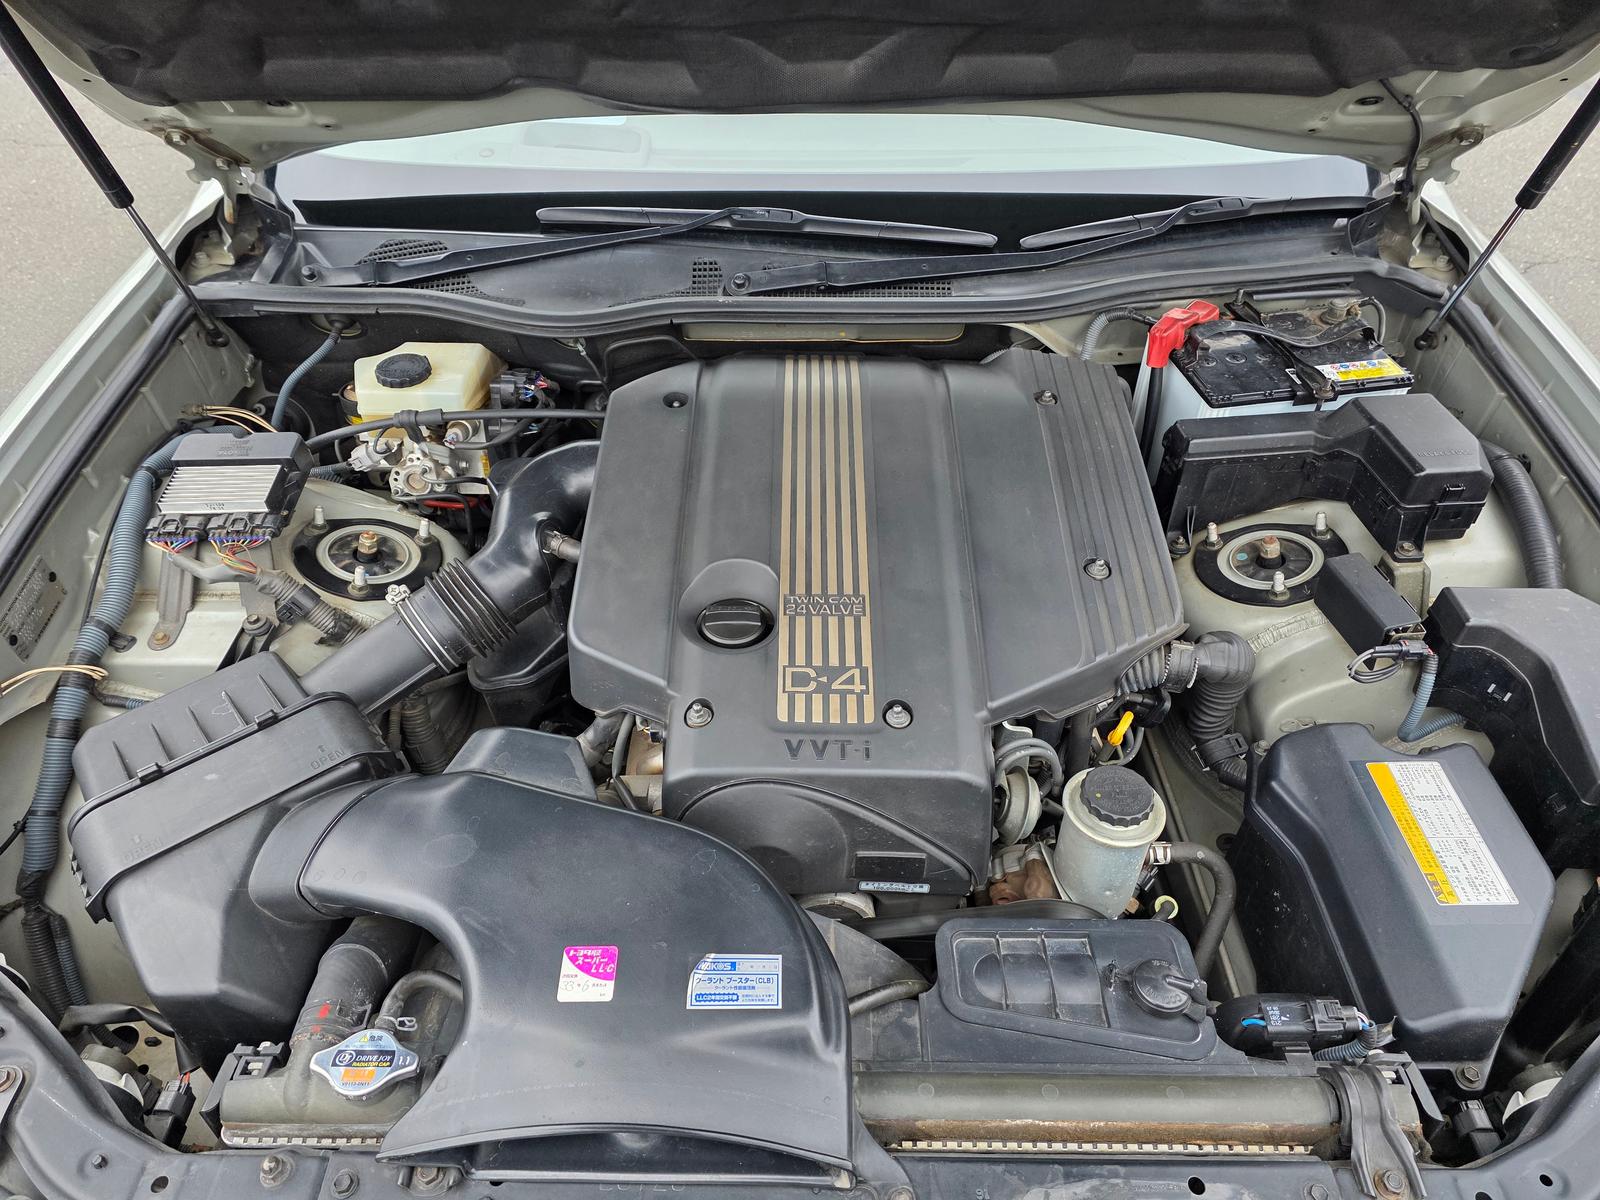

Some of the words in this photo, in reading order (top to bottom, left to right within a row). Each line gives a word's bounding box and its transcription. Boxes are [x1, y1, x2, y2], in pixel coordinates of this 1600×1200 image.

[784, 739, 871, 761] VVT-i
[310, 750, 345, 770] OPEN
[575, 956, 608, 965] スーパー
[591, 964, 615, 973] LLC
[695, 976, 724, 984] クーラント
[399, 1056, 411, 1066] 1.1
